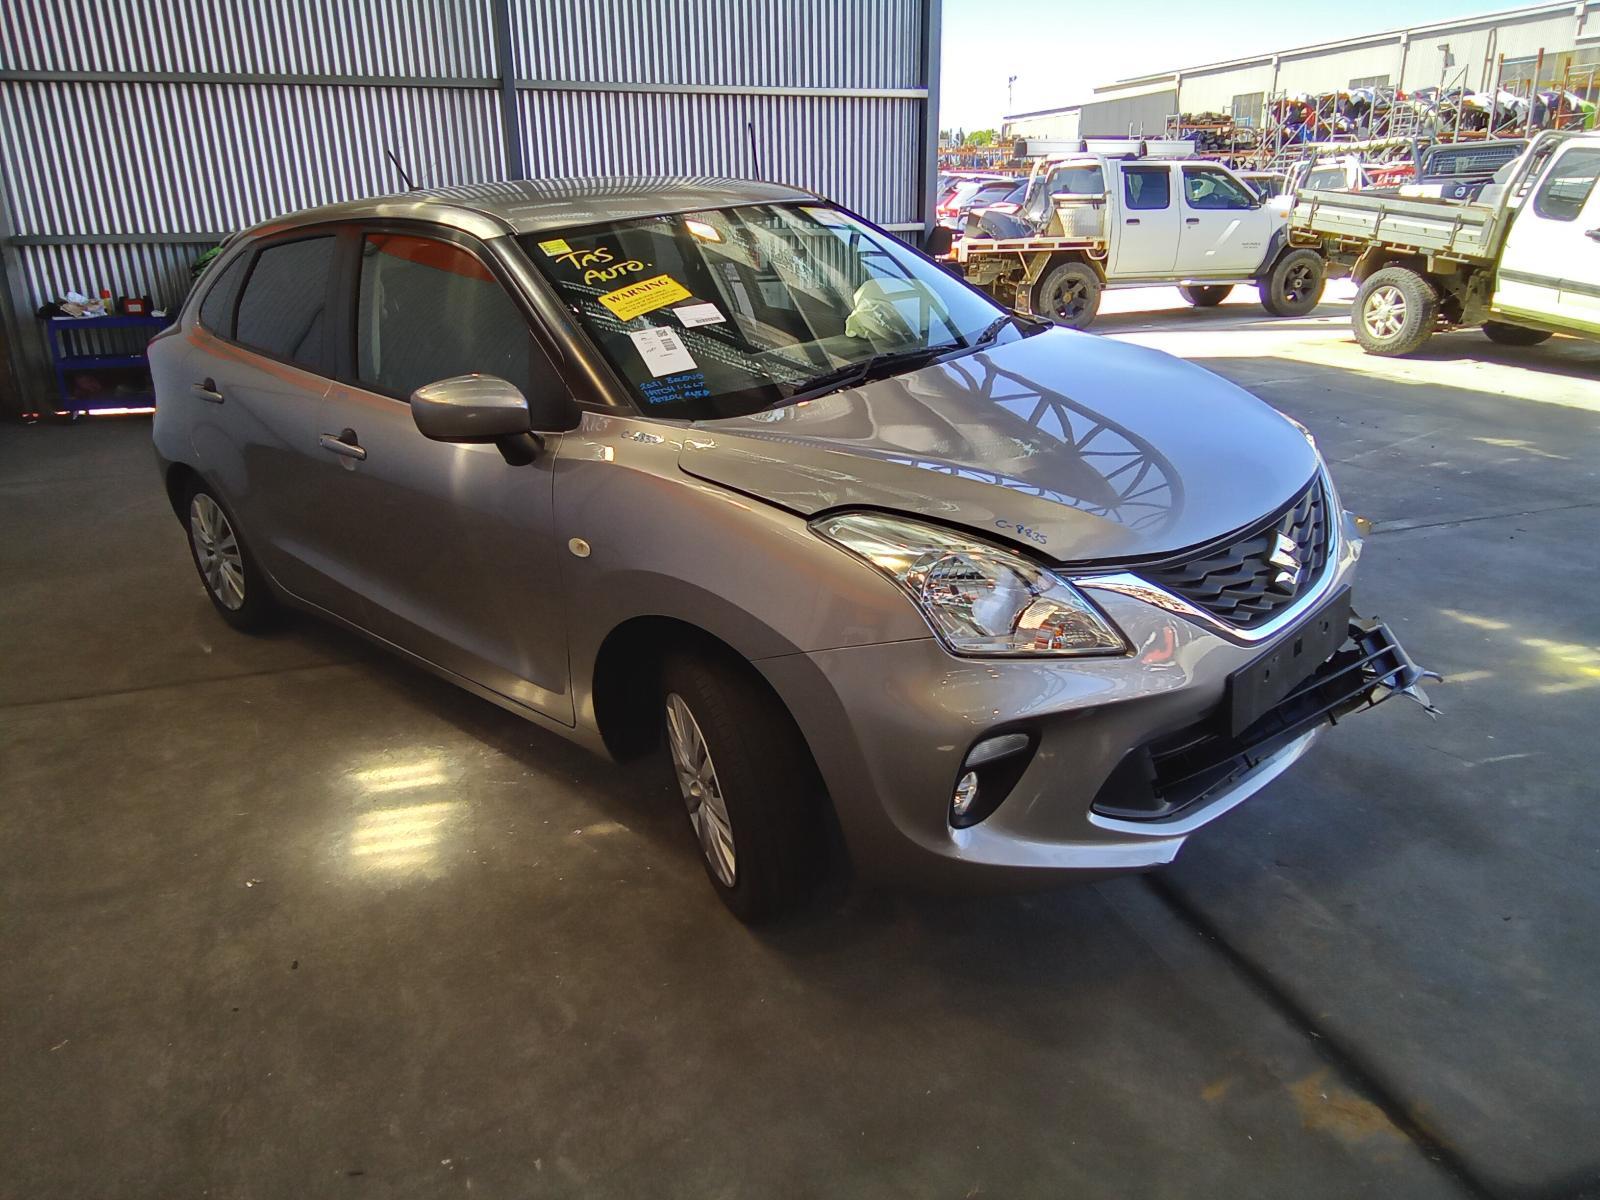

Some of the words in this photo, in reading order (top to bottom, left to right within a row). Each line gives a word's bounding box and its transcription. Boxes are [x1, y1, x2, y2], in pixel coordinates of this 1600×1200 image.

[556, 247, 614, 270] TAS
[607, 279, 669, 303] WARNING
[995, 519, 1048, 545] C-8835
